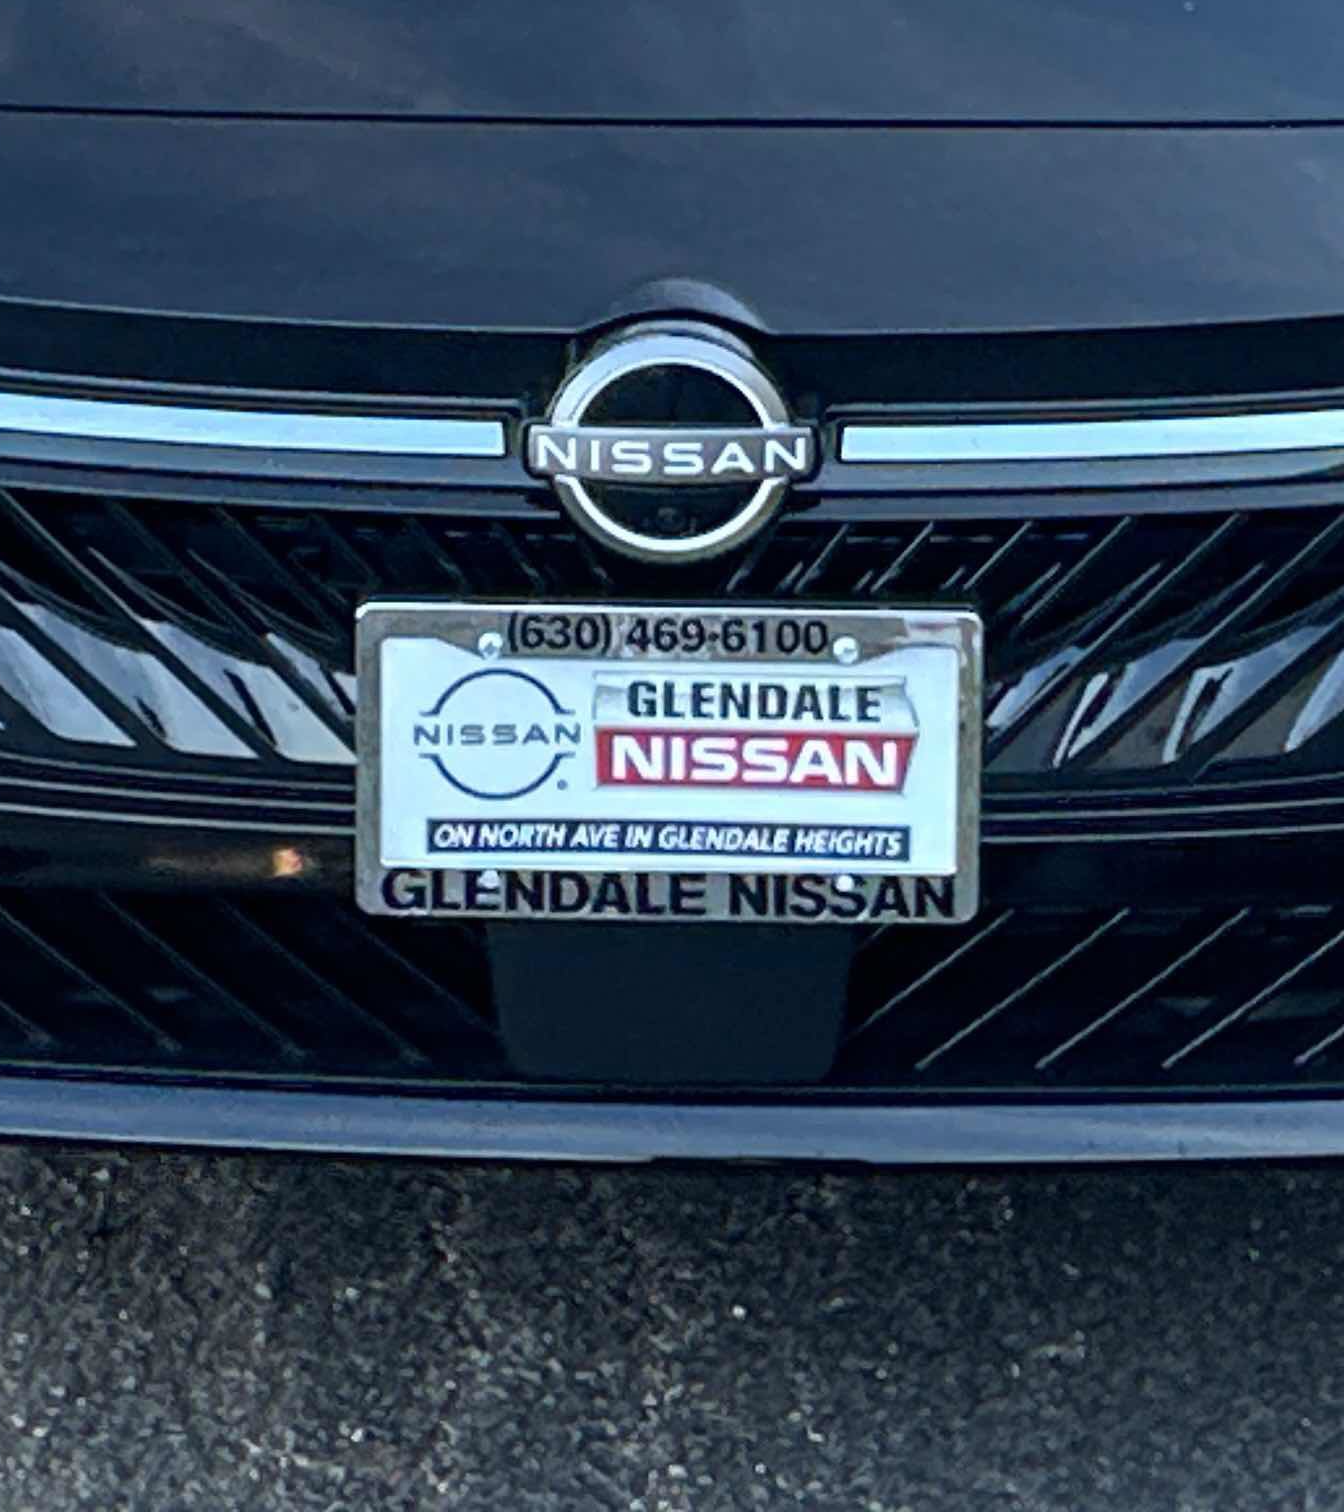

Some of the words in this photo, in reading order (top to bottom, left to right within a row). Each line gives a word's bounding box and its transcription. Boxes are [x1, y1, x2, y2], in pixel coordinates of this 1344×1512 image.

[537, 435, 806, 475] NISSAN
[507, 612, 611, 653] (630)
[627, 680, 882, 723] GLENDALE
[413, 723, 581, 745] NISSAN
[612, 735, 898, 786] NISSAN
[433, 823, 475, 848] ON
[479, 823, 567, 849] NORTH
[569, 824, 621, 849] AVE
[624, 824, 654, 849] IN
[658, 824, 790, 854] GLENDALE
[793, 826, 903, 858] HEIGHTS
[381, 868, 706, 917] GLENDALE
[728, 872, 954, 919] NISSAN
